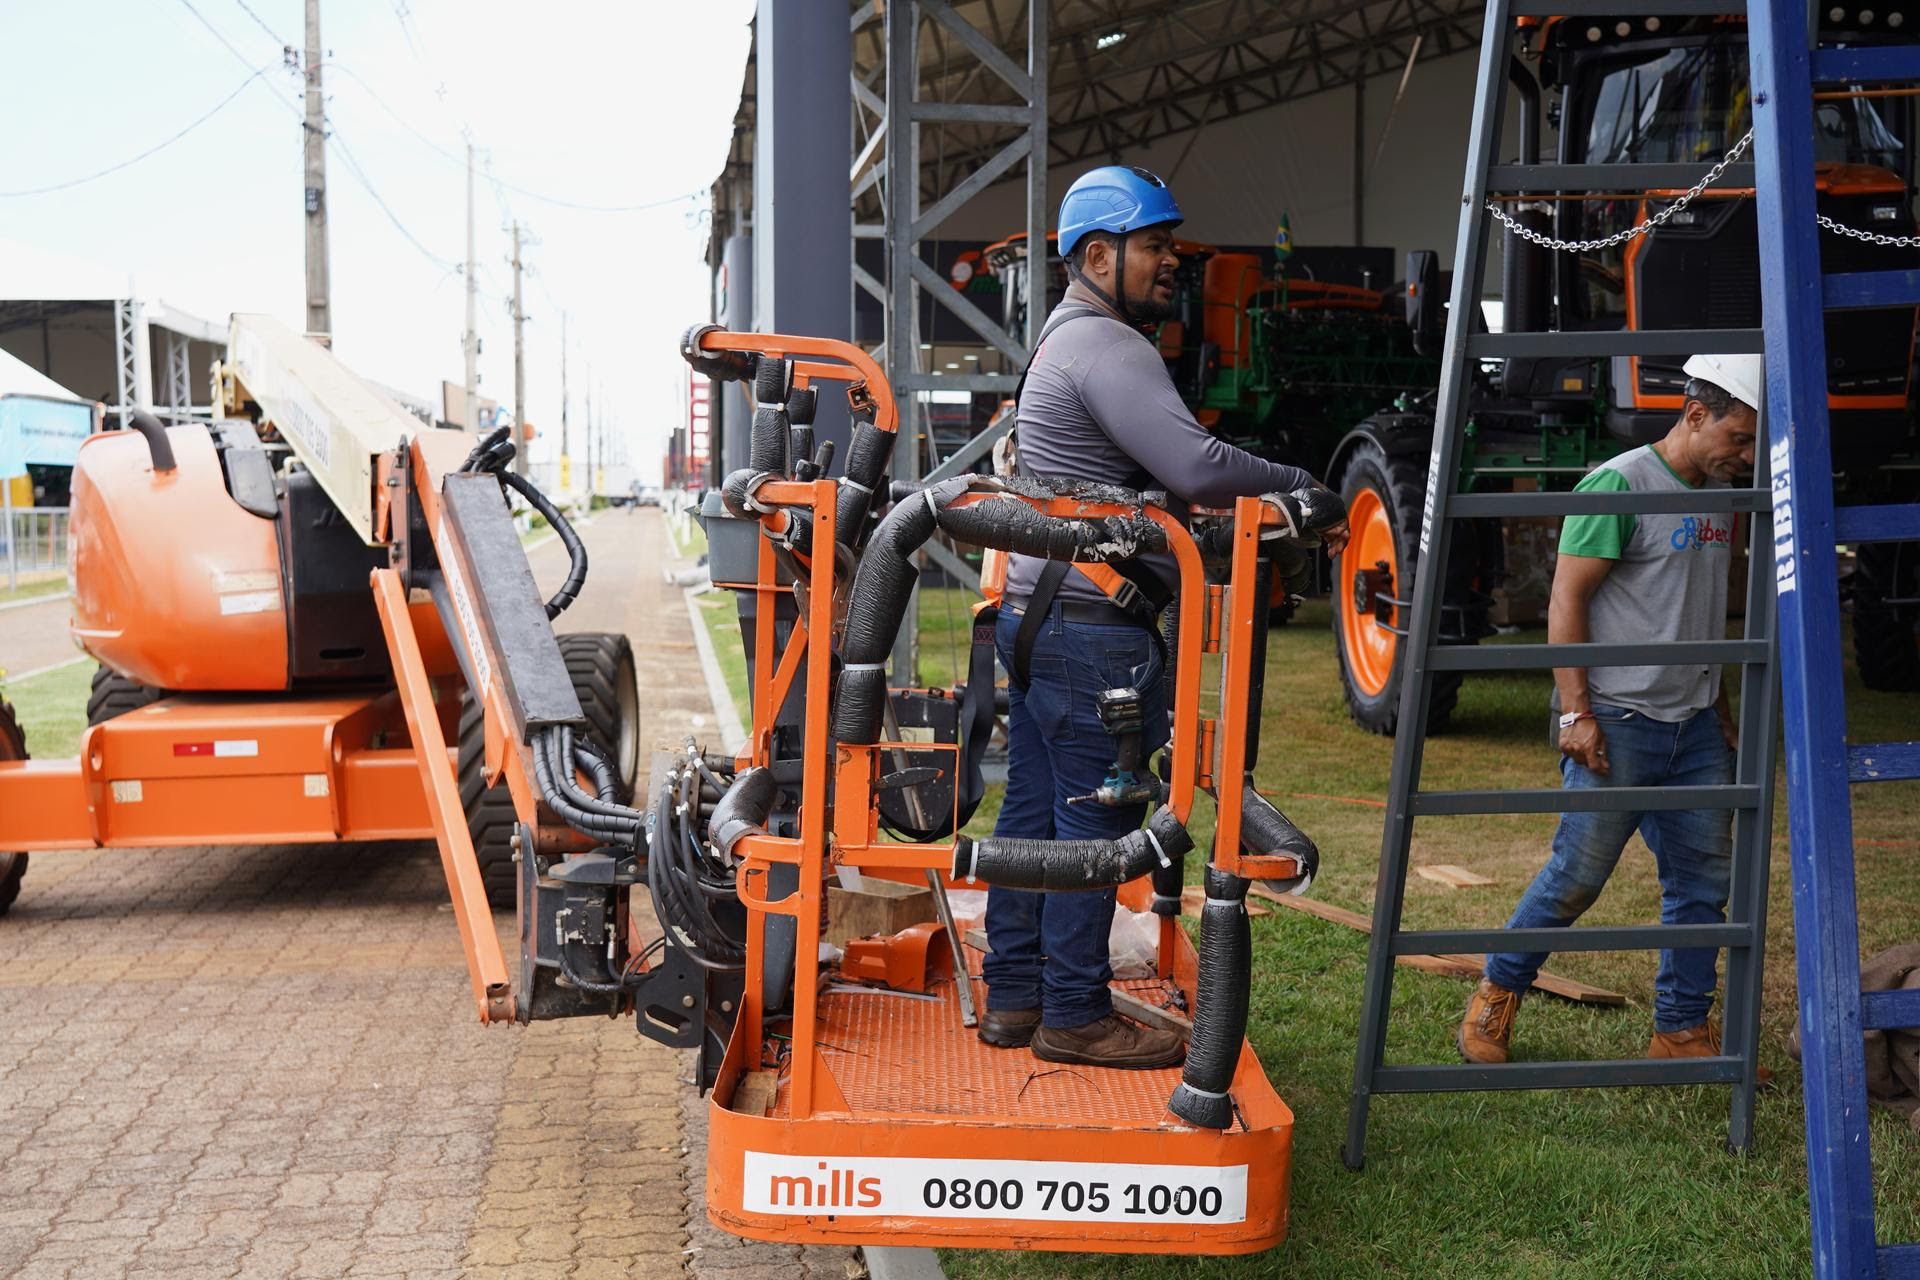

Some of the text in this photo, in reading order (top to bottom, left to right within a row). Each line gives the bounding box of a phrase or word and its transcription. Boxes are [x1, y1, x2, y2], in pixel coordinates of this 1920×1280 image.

[1420, 451, 1440, 555] RIBER
[1770, 436, 1796, 595] RIBER
[770, 1162, 1222, 1216] mills 0800 705 1000
